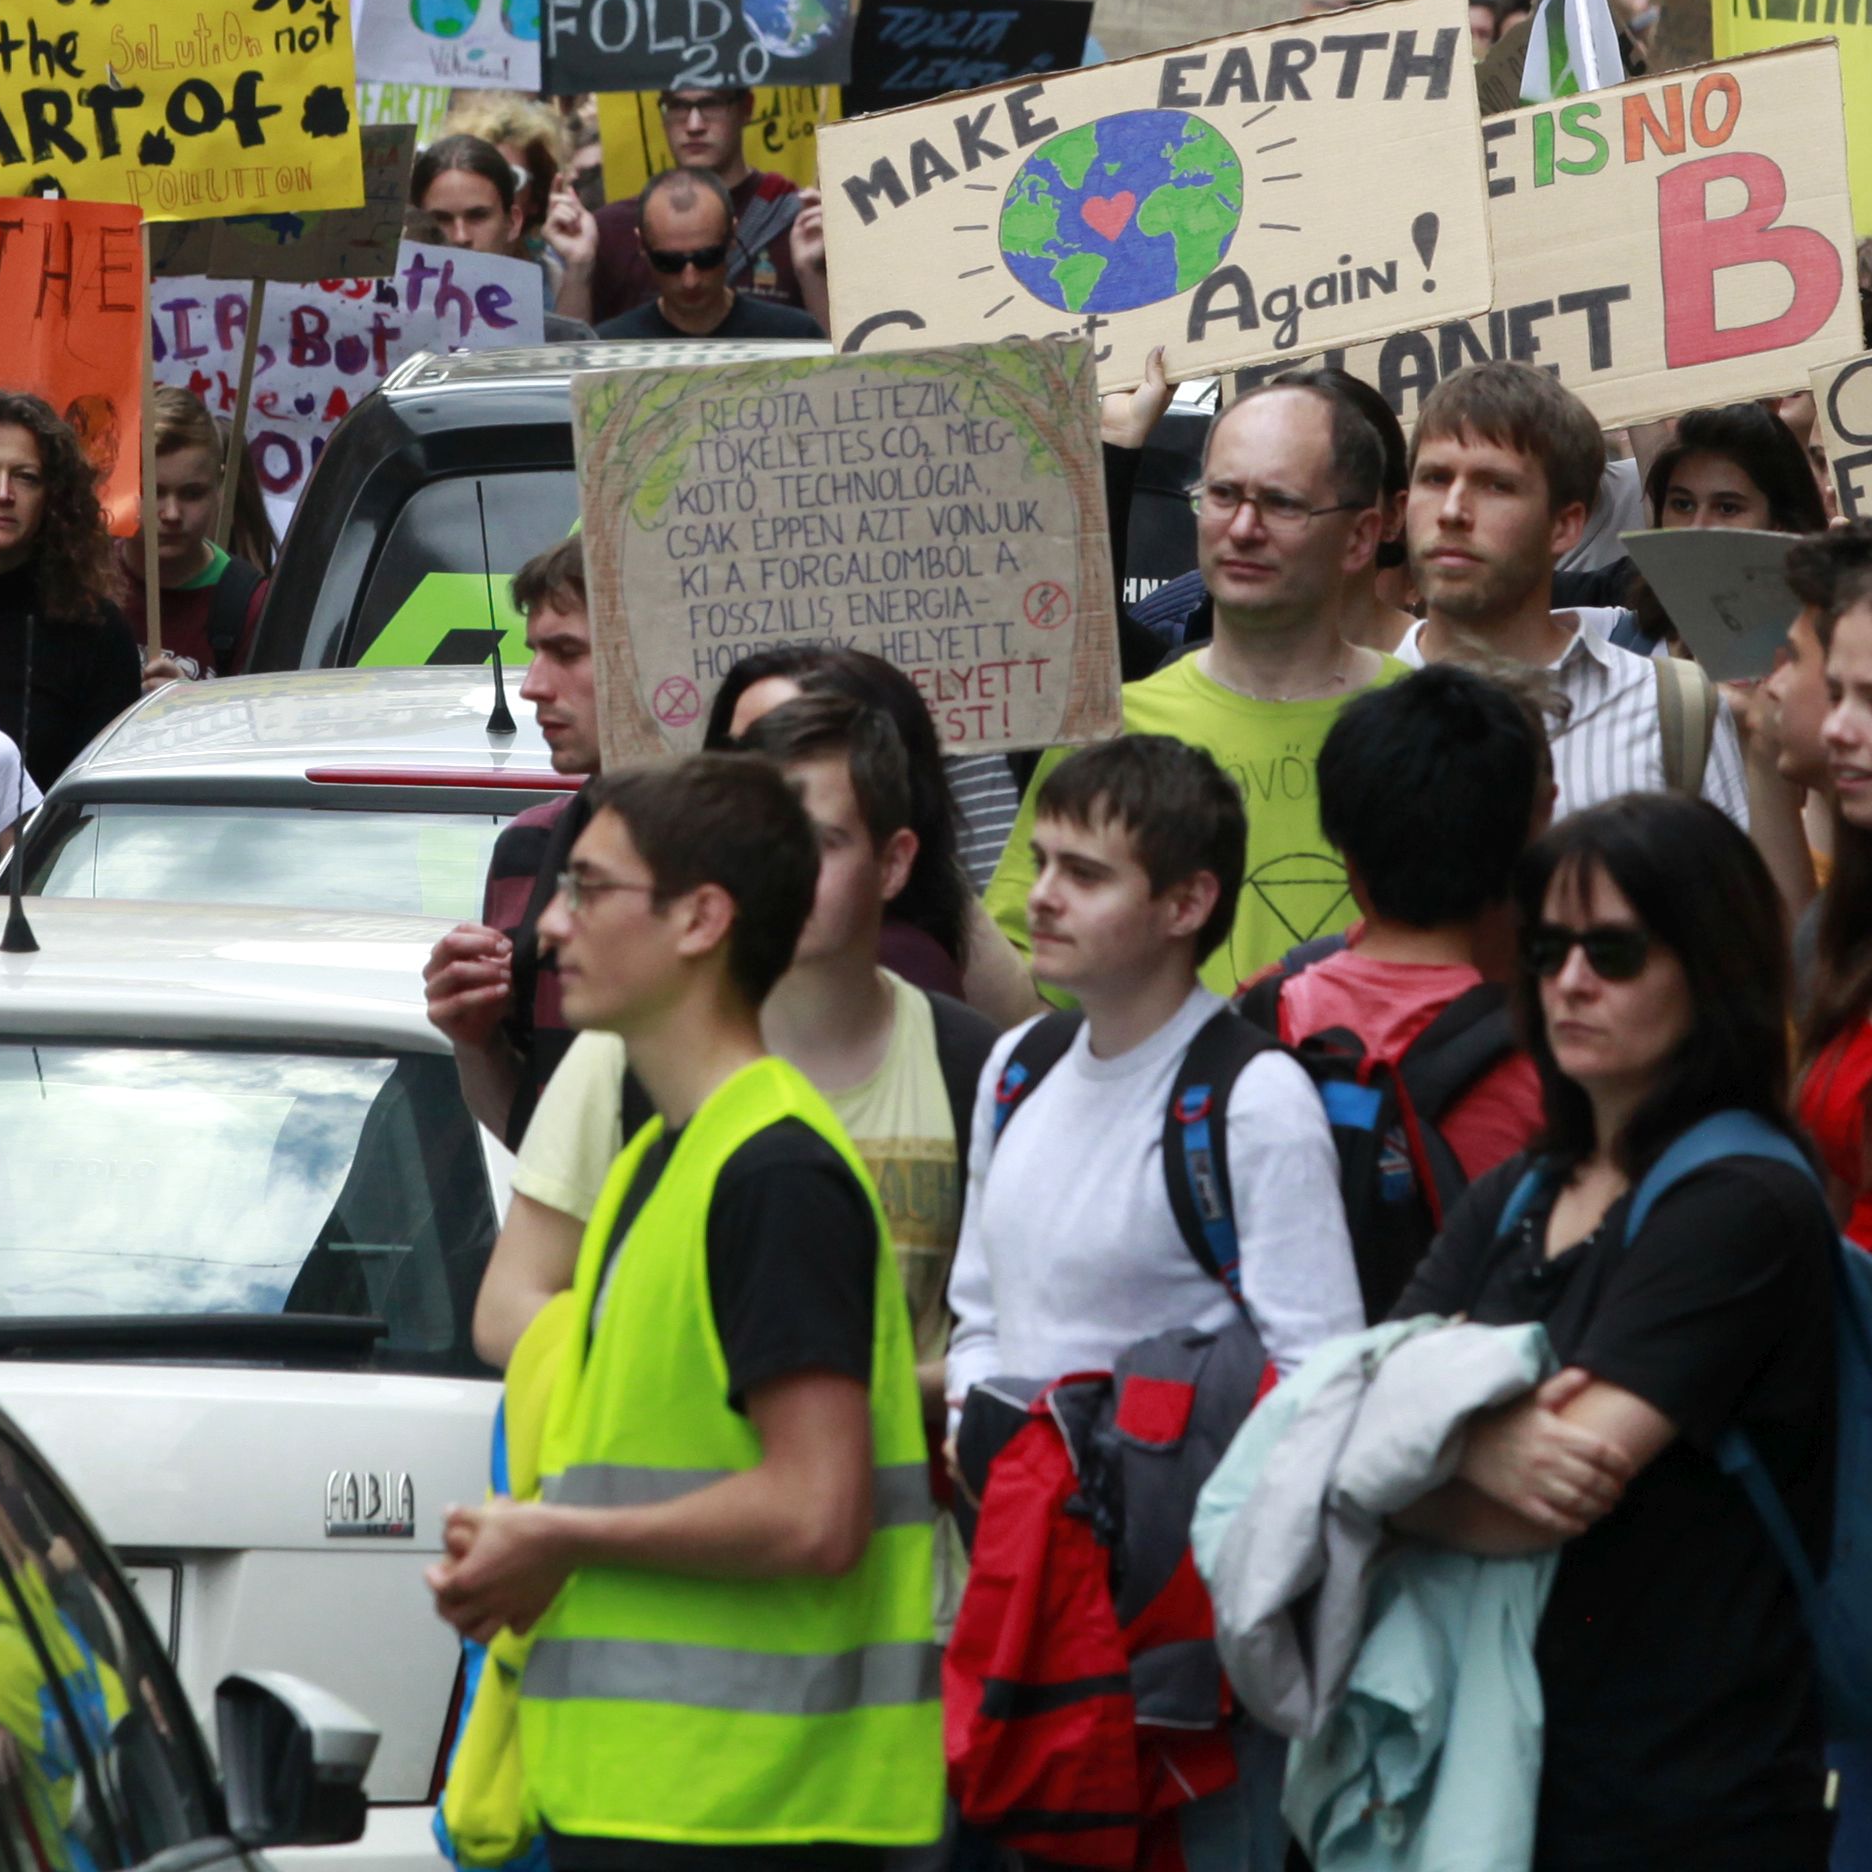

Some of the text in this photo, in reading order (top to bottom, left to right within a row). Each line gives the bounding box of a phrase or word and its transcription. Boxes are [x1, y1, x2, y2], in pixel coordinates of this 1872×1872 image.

[274, 0, 341, 56] not
[669, 41, 771, 89] 2.0
[841, 27, 1460, 226] MAKE EARTH
[1531, 101, 1610, 188] IS
[1621, 71, 1742, 165] NO
[1658, 151, 1845, 371] B
[403, 252, 519, 337] the
[834, 374, 960, 425] LÉTEZIK
[666, 520, 739, 561] CSAK
[856, 507, 912, 543] AZT
[926, 499, 1045, 540] VONJUK
[679, 564, 709, 599] KI
[727, 561, 746, 595] A
[995, 541, 1021, 574] A
[689, 595, 834, 640] FOSSZILIS
[325, 1470, 415, 1521] FABIA
